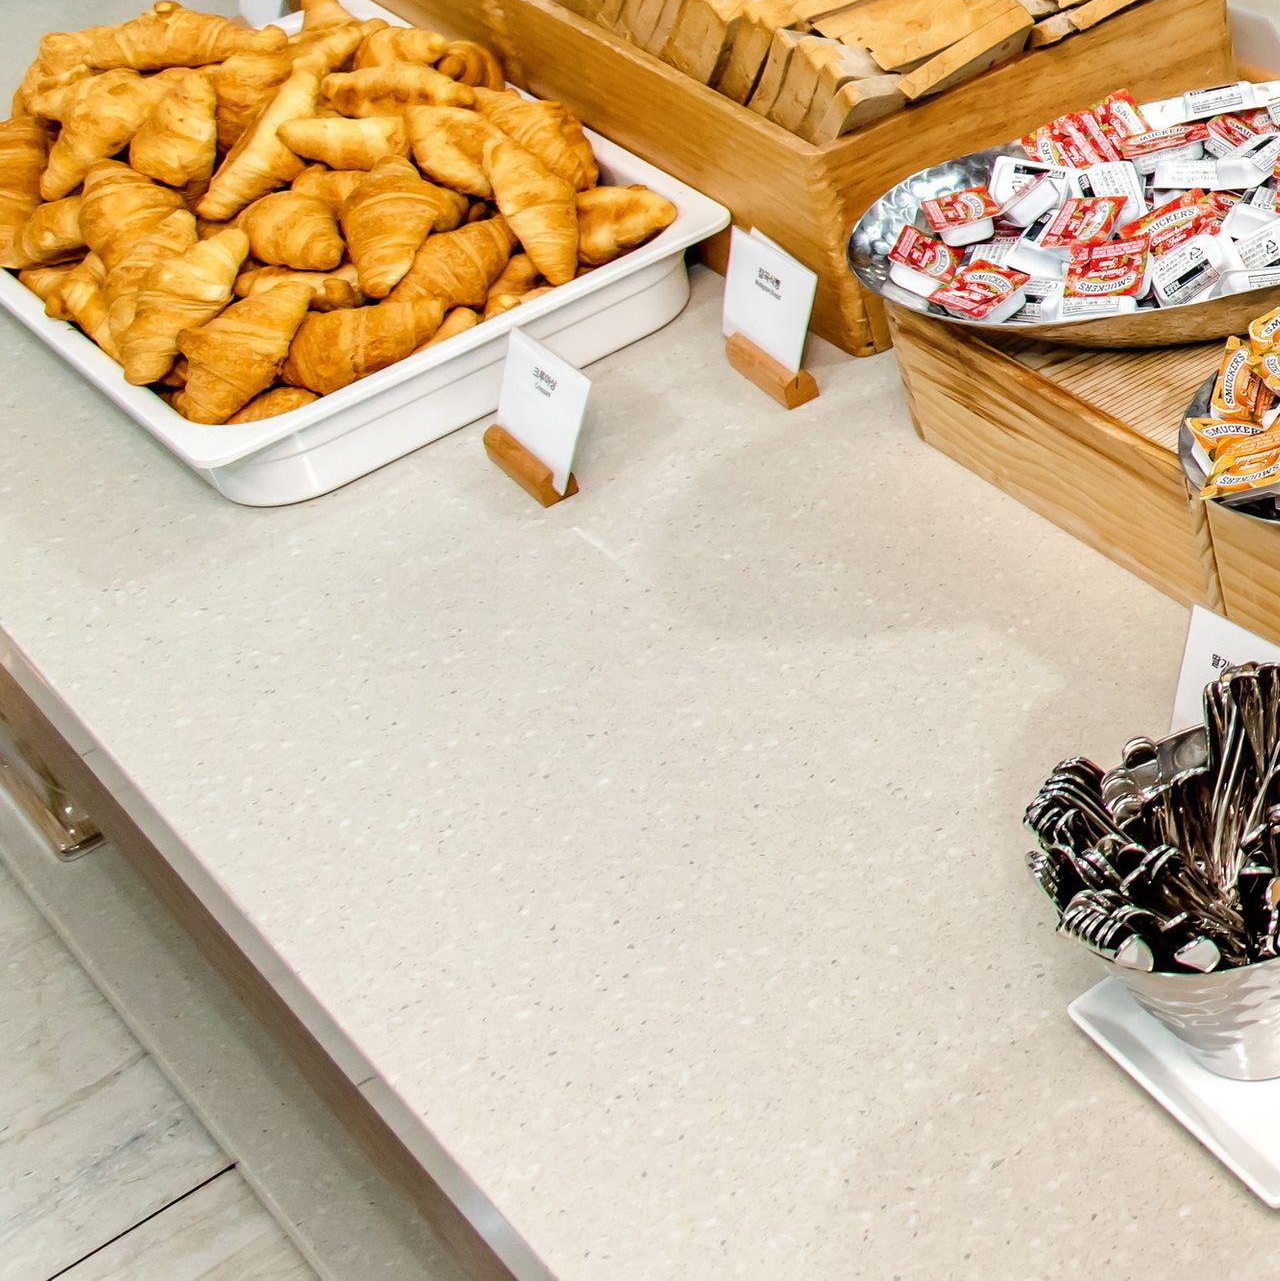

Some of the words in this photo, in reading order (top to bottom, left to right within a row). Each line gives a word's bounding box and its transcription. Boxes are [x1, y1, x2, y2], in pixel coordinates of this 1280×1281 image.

[1147, 208, 1196, 235] MUCKER'S
[1078, 275, 1134, 294] SMUCKER'S
[1225, 353, 1246, 405] SMUCKER'S
